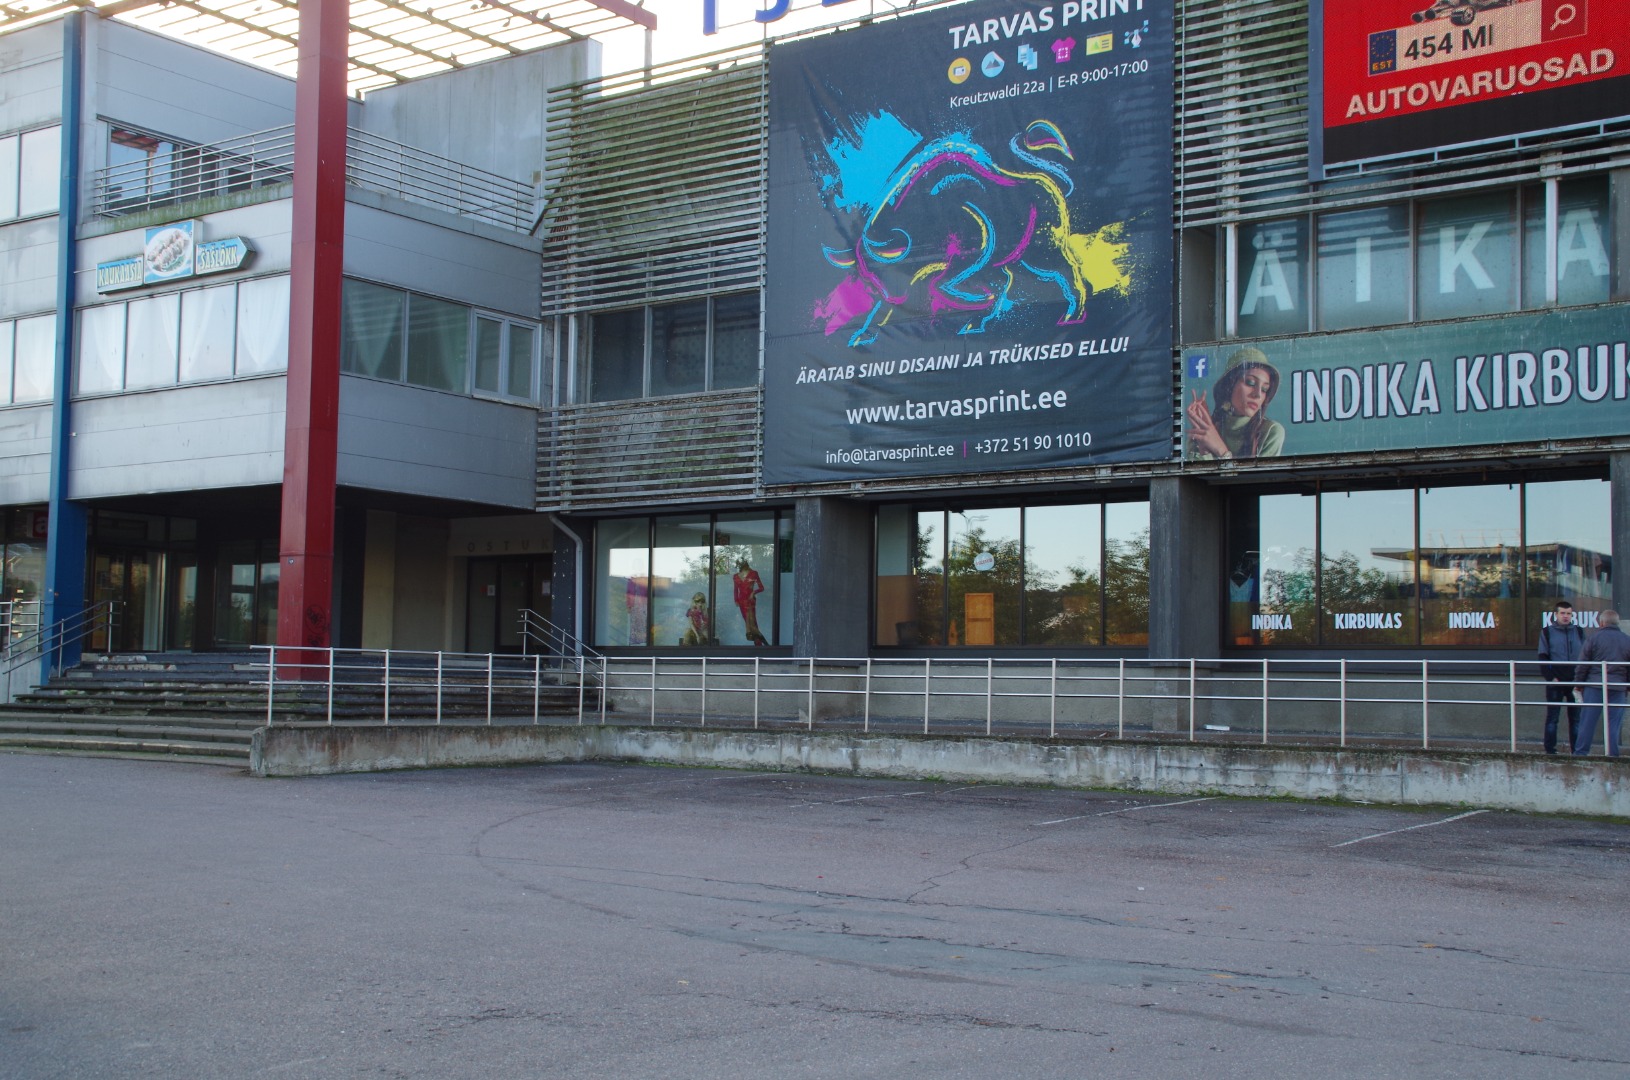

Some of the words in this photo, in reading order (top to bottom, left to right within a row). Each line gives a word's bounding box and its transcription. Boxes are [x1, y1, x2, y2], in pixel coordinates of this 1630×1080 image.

[948, 7, 1055, 50] TARVAS
[1404, 32, 1453, 61] 454
[1372, 59, 1393, 72] EST
[950, 83, 1020, 108] Kreutzwaldi
[1023, 80, 1045, 95] 22a
[1057, 73, 1079, 88] E-R
[1081, 59, 1149, 84] 9:00-17:00
[1345, 48, 1616, 119] AUTOVARUOSAD
[98, 260, 142, 286] KAUKAASIA
[796, 365, 855, 385] ÄRATAB
[858, 360, 896, 378] SINU
[899, 354, 959, 374] DISAINI
[962, 351, 983, 368] JA
[989, 342, 1074, 365] TRÜKISED
[1077, 336, 1130, 357] ELLU!
[846, 389, 1067, 425] www.tarvasprint.ee
[1291, 359, 1440, 424] INDIKA
[826, 443, 955, 465] info@tarvasprint.ee
[974, 438, 1009, 454] +372
[1012, 436, 1028, 452] 51
[1033, 434, 1052, 450] 90
[1056, 431, 1092, 448] 1010
[1252, 614, 1293, 630] INDIKA
[1335, 612, 1402, 630] KIRBUKAS
[1449, 611, 1496, 629] INDIKA
[1543, 610, 1601, 629] KBUK
